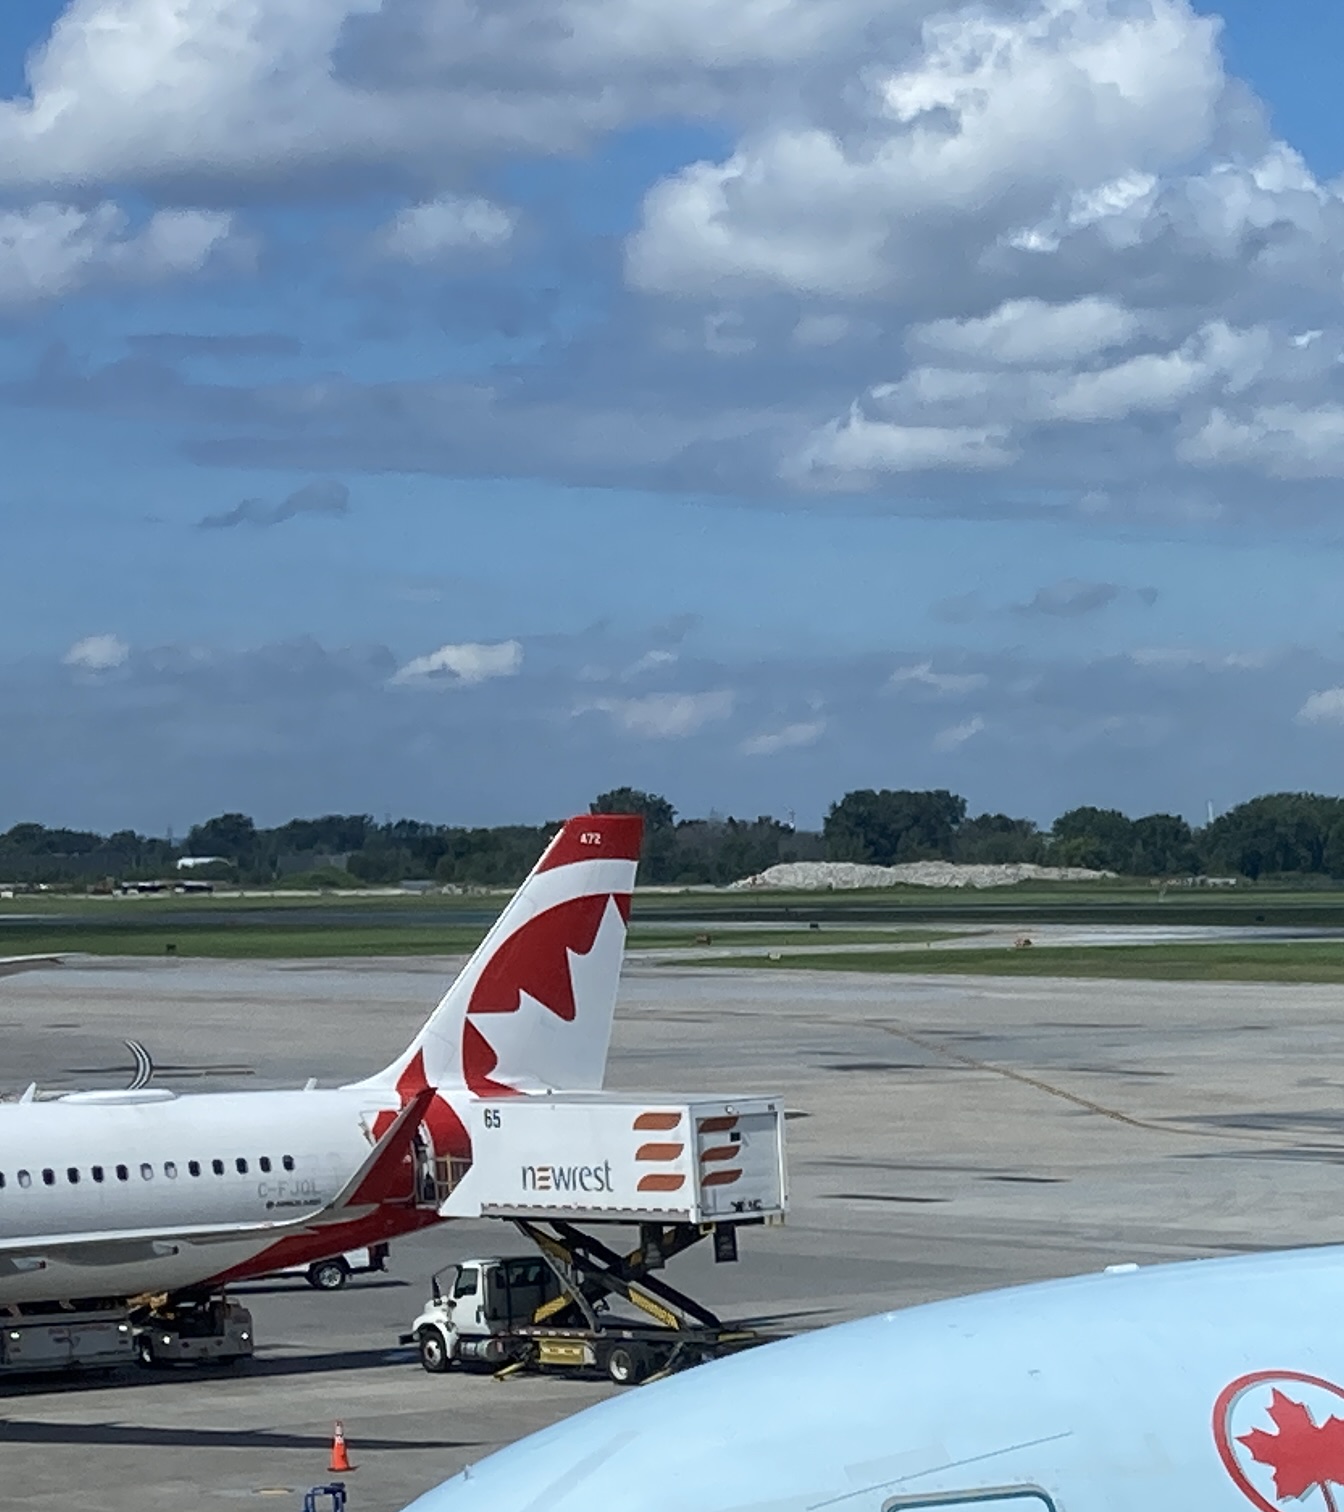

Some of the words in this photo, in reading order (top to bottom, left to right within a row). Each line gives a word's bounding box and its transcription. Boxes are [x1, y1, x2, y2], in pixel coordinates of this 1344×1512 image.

[580, 832, 602, 845] 472
[484, 1108, 501, 1129] 65
[521, 1159, 614, 1192] newrest
